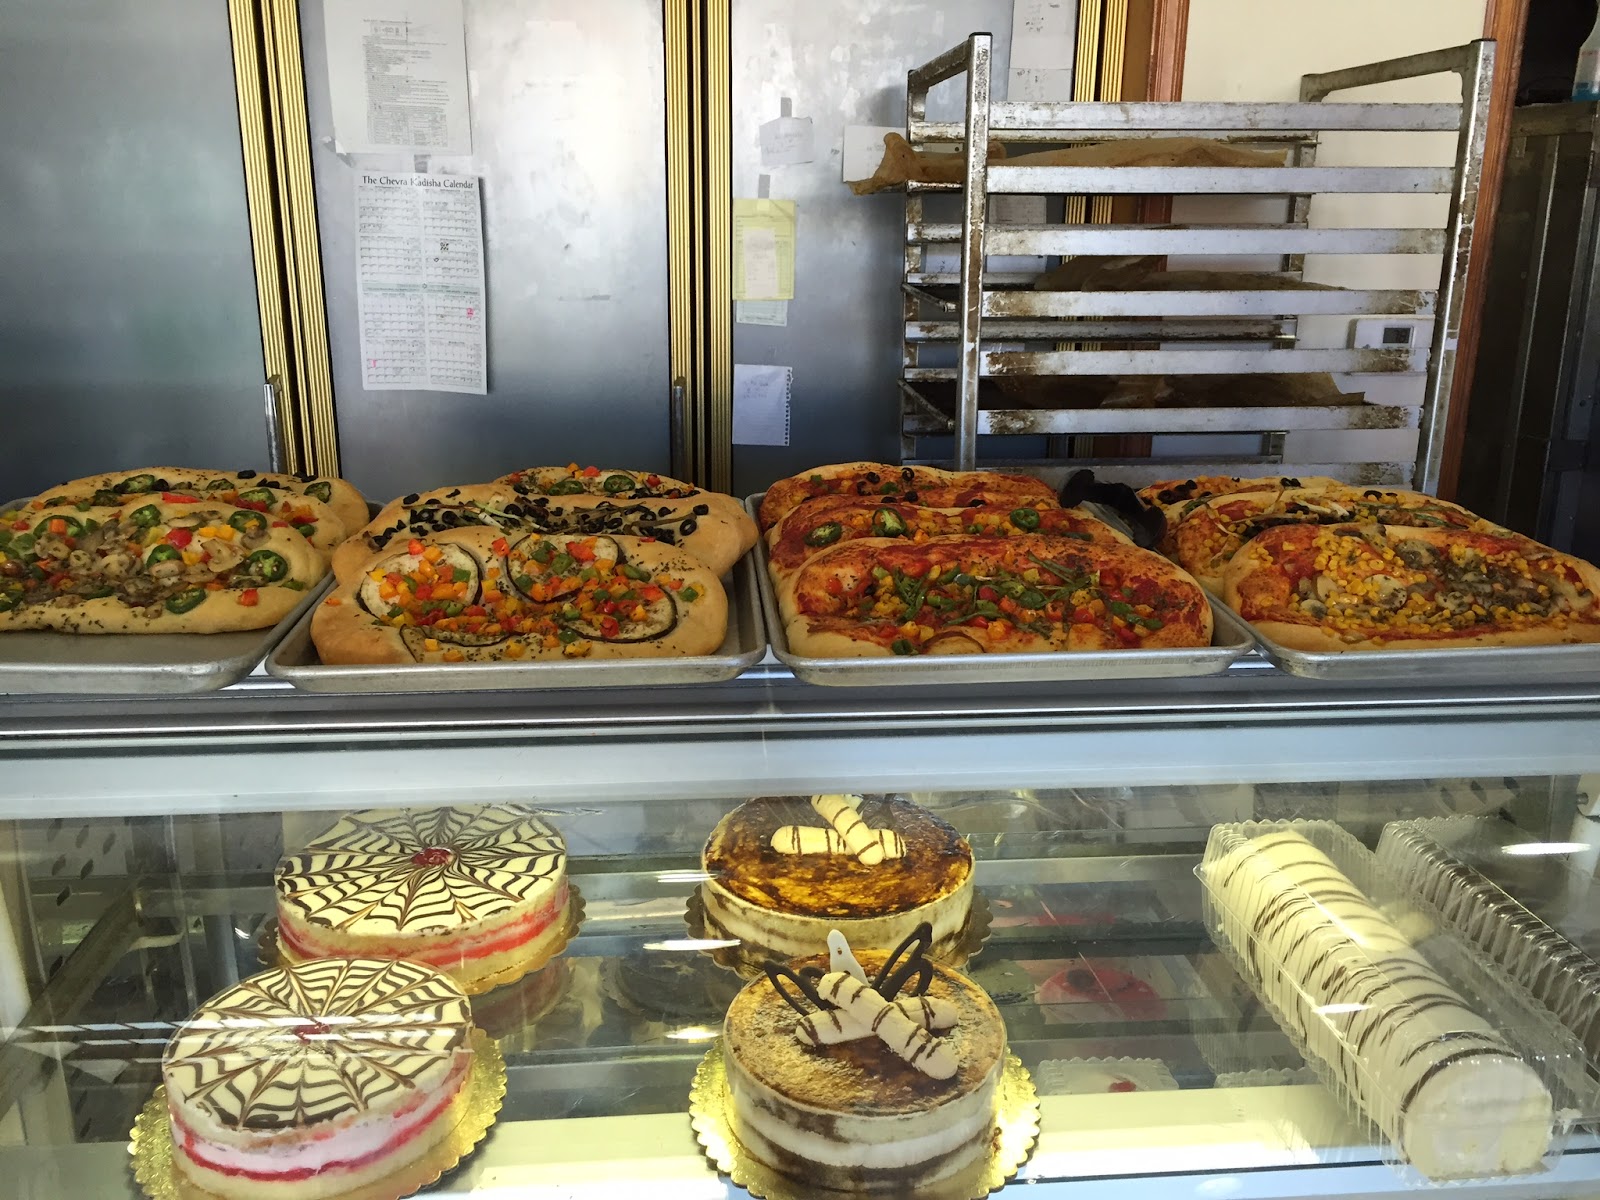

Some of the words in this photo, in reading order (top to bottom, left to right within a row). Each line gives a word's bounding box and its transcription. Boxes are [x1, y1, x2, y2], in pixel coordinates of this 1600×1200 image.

[362, 175, 377, 185] The
[379, 176, 408, 186] Chevra
[410, 177, 442, 188] Kadisha
[443, 179, 474, 189] Calendar
